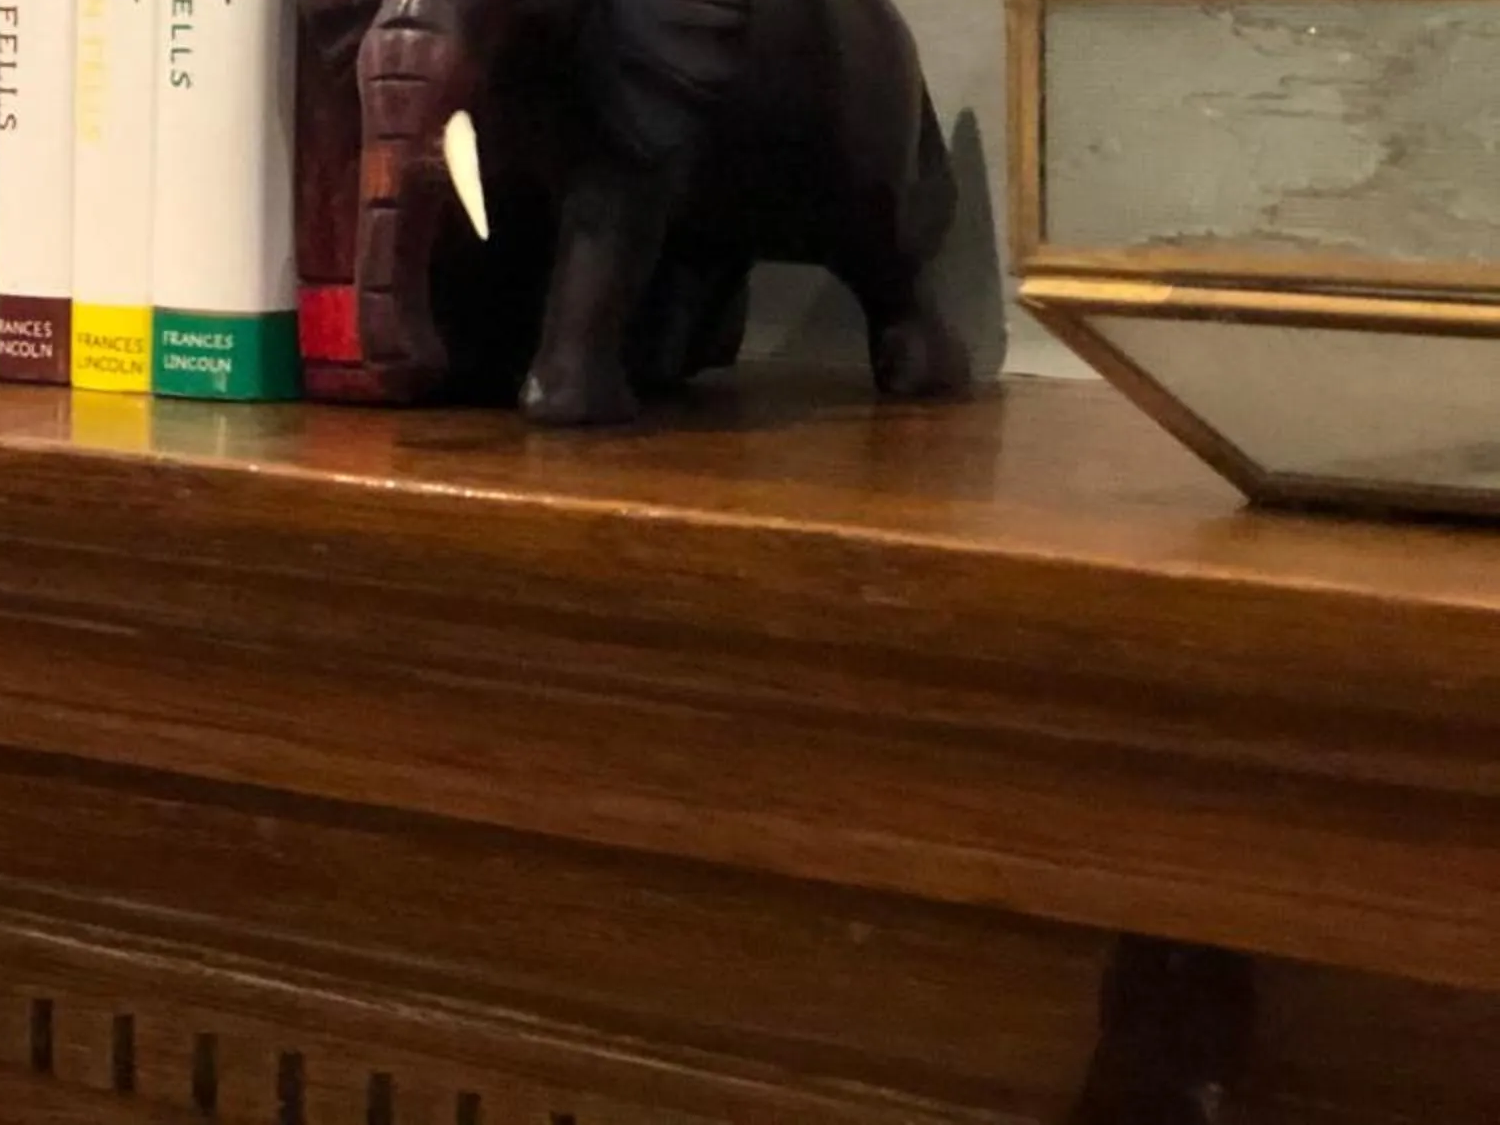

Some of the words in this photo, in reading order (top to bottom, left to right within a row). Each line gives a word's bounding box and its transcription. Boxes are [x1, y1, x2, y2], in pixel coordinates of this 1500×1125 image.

[76, 332, 145, 355] FRANCES
[162, 329, 235, 351] FRANCES
[163, 353, 232, 374] LINCOLN
